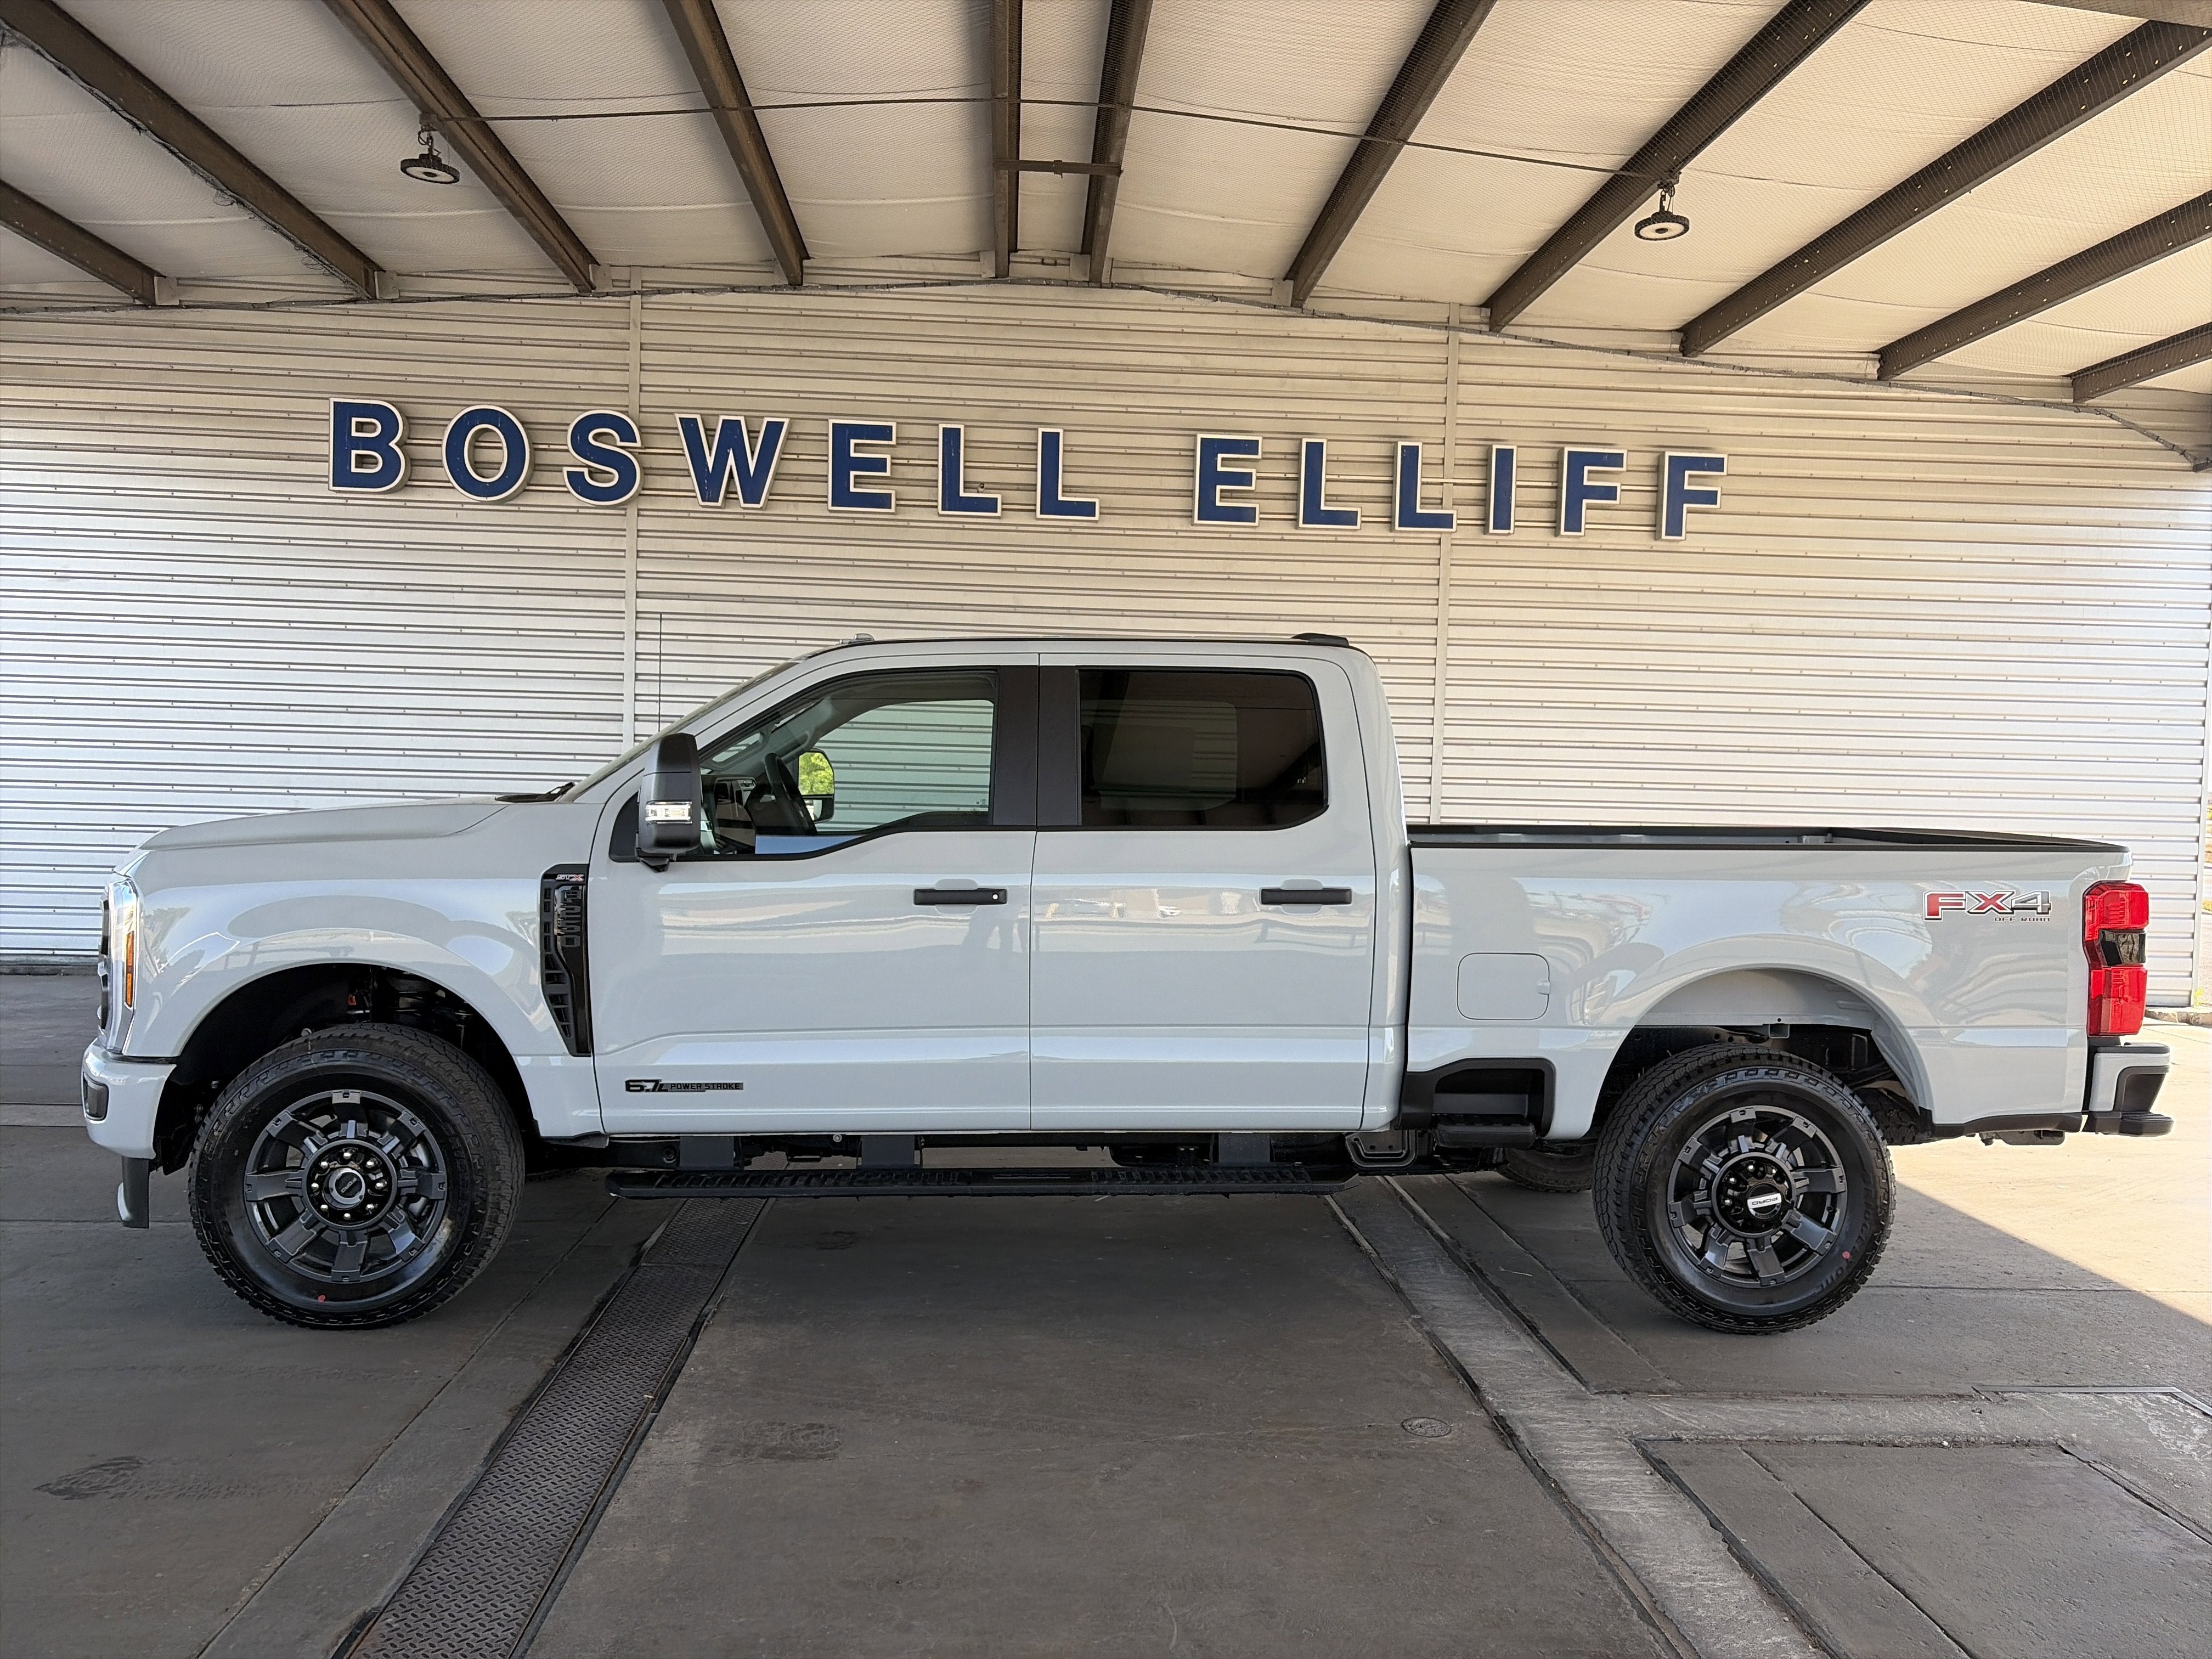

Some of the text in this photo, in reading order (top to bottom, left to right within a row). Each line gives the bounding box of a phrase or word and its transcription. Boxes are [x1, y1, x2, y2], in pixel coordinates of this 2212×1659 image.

[329, 398, 1729, 541] BOSWELL ELLIFF
[1923, 890, 2051, 921] FX4
[625, 1079, 669, 1092] 6.7L
[340, 1177, 357, 1194] FORD
[1751, 1197, 1778, 1205] FORD
